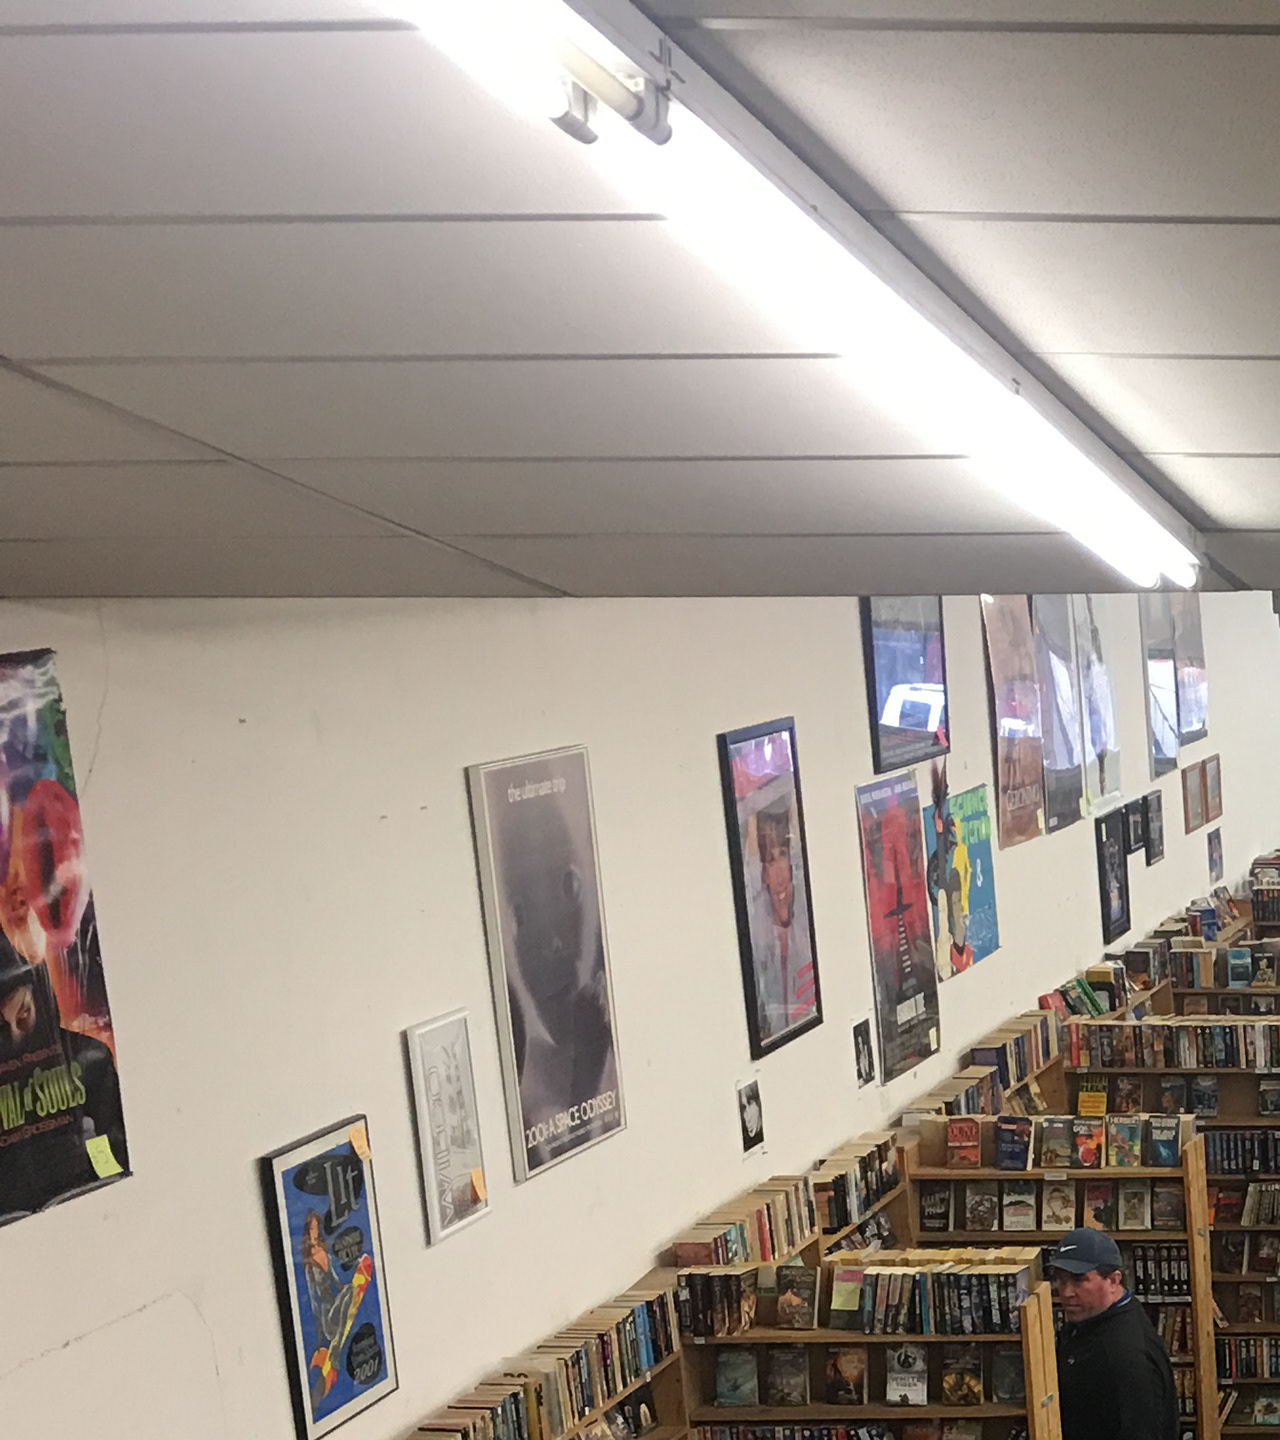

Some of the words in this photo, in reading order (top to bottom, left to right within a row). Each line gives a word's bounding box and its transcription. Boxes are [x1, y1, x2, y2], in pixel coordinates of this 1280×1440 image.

[508, 782, 521, 802] the
[522, 779, 552, 799] ultimate
[33, 1061, 86, 1117] SOULS
[549, 1118, 557, 1137] A
[555, 1105, 581, 1133] SPACE
[580, 1089, 617, 1120] ODYSSEY
[353, 1357, 379, 1385] 2001
